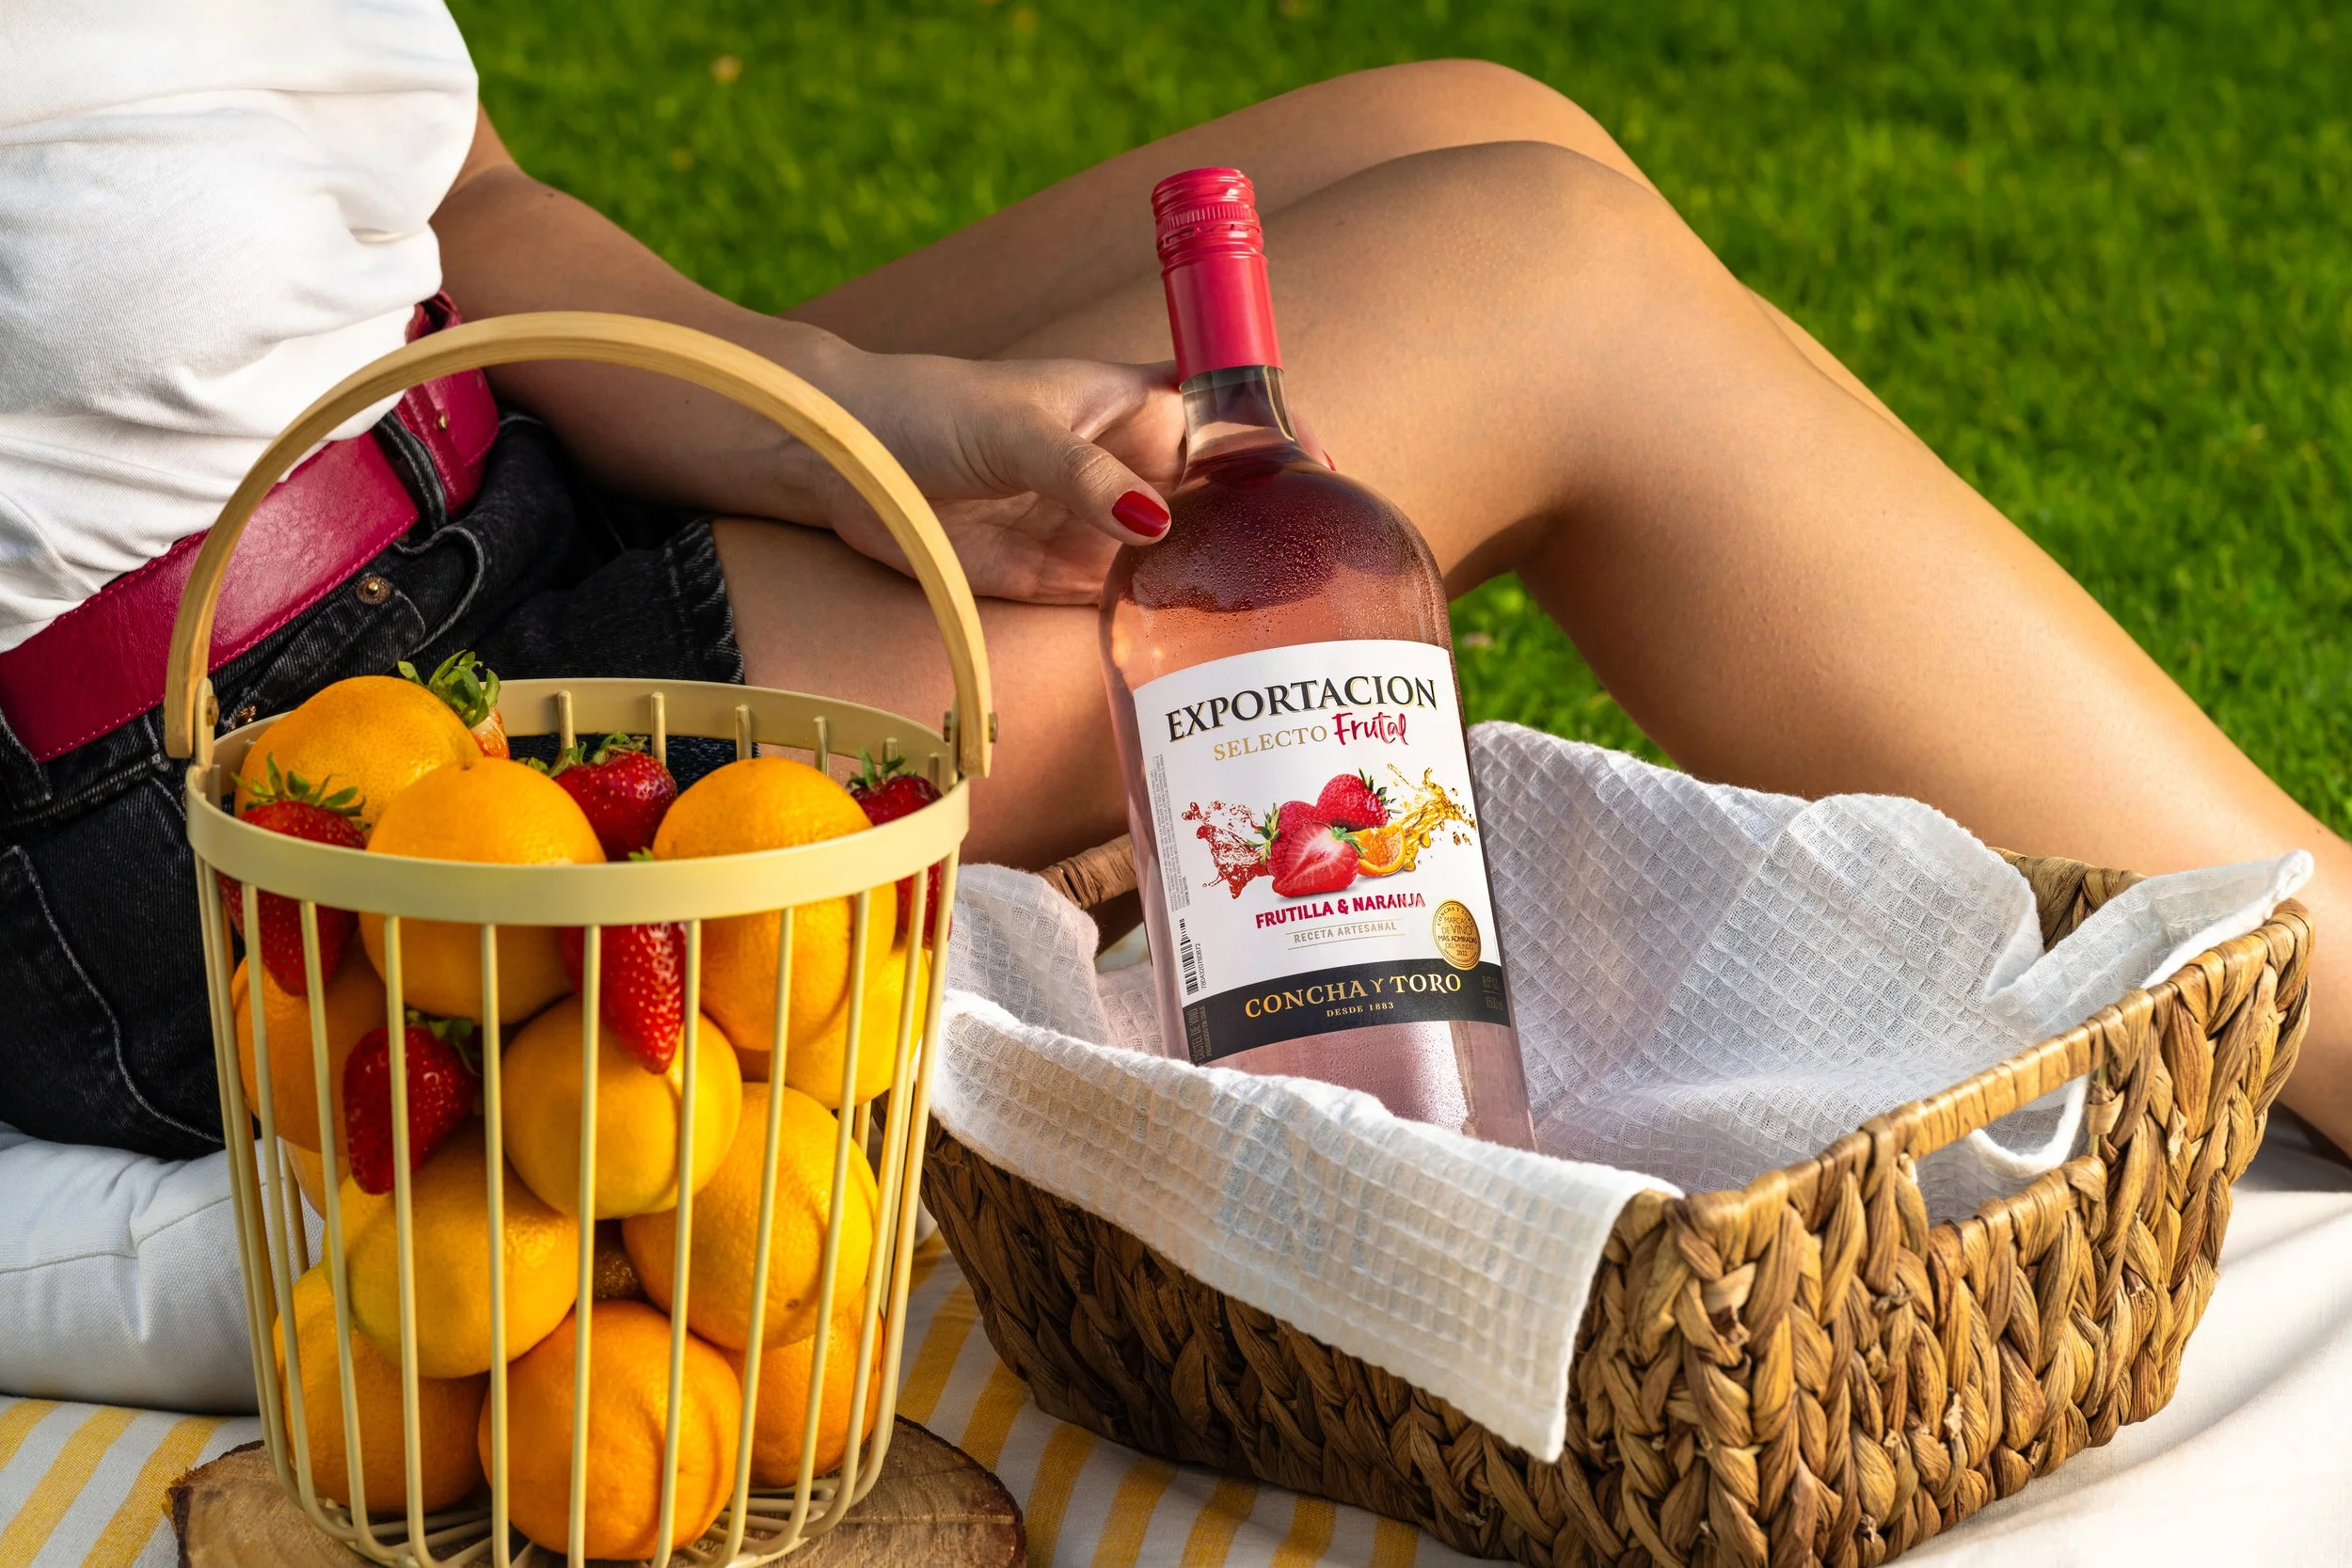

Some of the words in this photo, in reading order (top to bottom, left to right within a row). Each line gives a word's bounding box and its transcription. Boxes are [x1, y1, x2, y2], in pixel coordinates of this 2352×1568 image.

[1166, 675, 1438, 743] EXPORTACION
[1213, 725, 1327, 762] SELECTO
[1332, 712, 1409, 746] Frutal
[1255, 902, 1335, 929] FRUTILLA
[1337, 898, 1349, 915] &
[1353, 893, 1425, 913] NARANJA
[1294, 927, 1334, 943] RECETA
[1337, 921, 1397, 939] ARTESANAL
[1450, 924, 1473, 936] VINO
[1245, 978, 1369, 1019] CONCHA
[1370, 978, 1385, 994] Y
[1390, 974, 1462, 994] TORO
[1326, 1004, 1364, 1018] DESDE
[1368, 1001, 1394, 1012] 1883
